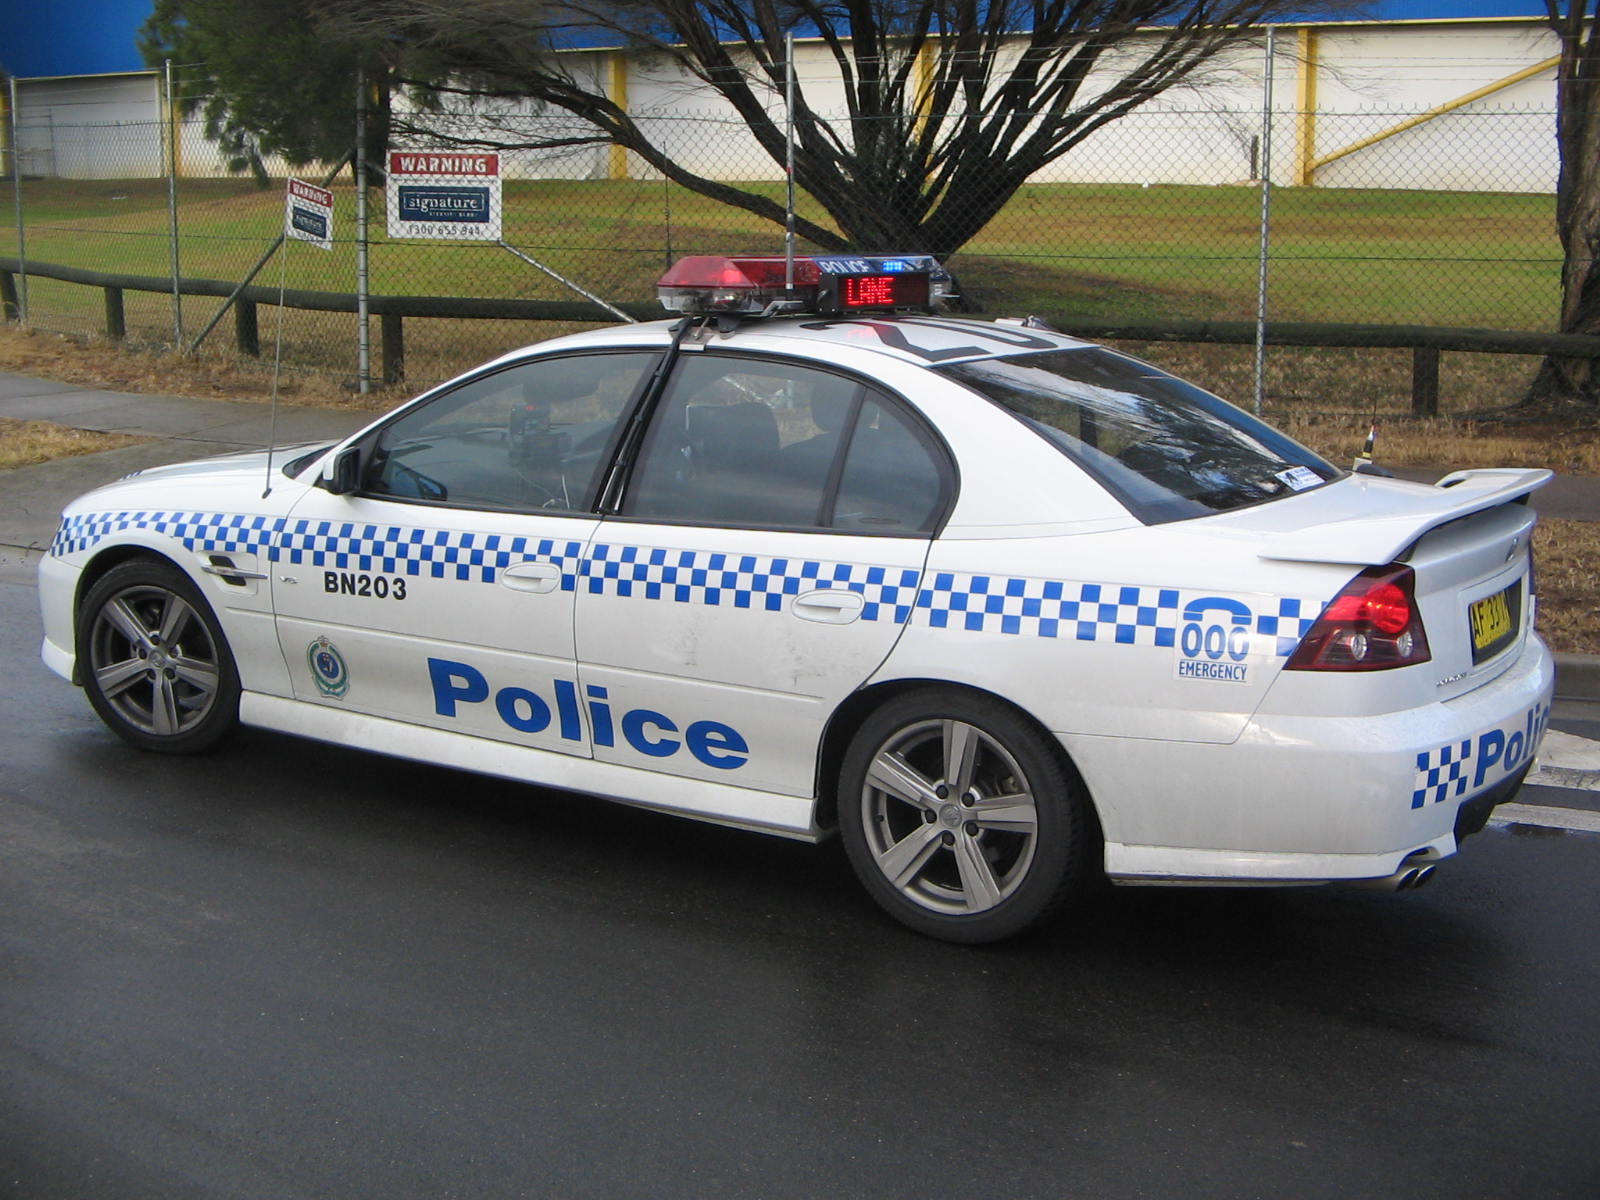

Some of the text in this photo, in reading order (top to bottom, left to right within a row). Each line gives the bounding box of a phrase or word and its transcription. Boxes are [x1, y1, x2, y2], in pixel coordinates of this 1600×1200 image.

[400, 156, 487, 173] WARNING
[293, 182, 328, 205] WARNING
[408, 195, 478, 212] signature
[408, 225, 434, 235] 1300
[819, 260, 870, 273] POLICE
[847, 276, 894, 305] LANE
[324, 571, 407, 600] BN203
[1181, 622, 1250, 661] 000
[1179, 660, 1248, 680] EMERGENCY
[427, 657, 749, 770] Police
